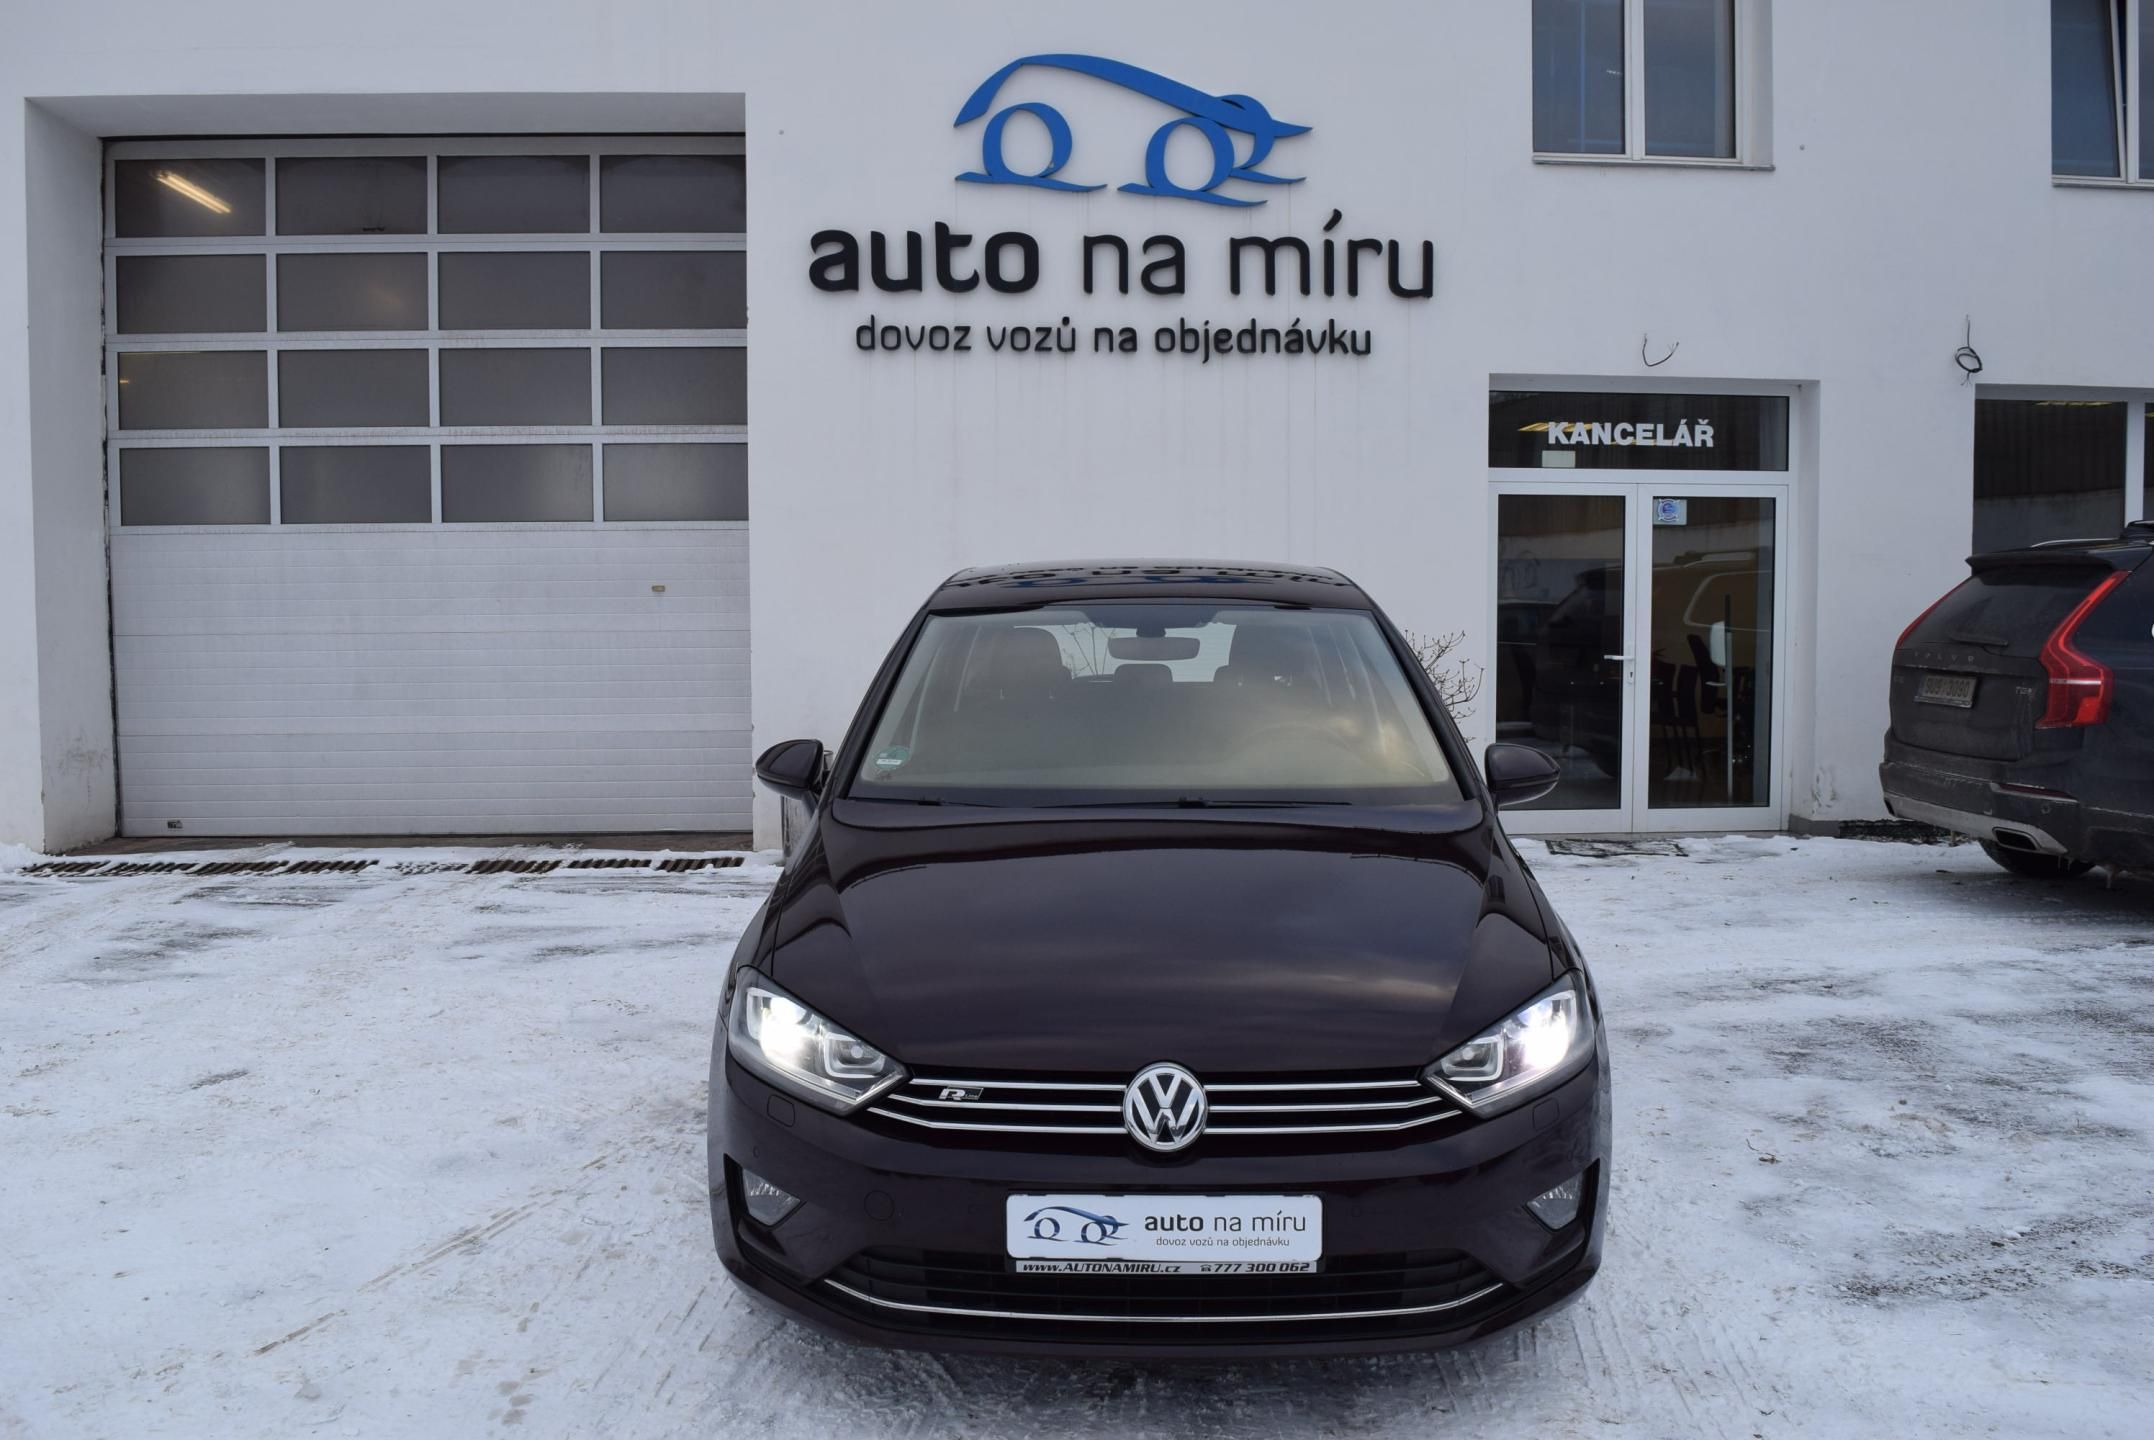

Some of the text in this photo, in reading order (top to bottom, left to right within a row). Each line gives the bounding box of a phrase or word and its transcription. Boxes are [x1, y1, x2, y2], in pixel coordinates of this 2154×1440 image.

[809, 208, 1434, 299] auto na míru
[856, 314, 1372, 364] dovoz vozů na objednávku
[1548, 418, 1715, 448] KANCELÁŘ
[1144, 1210, 1306, 1232] auto na míru
[1156, 1236, 1290, 1248] dovoz vozů na objednávku
[1023, 1263, 1310, 1273] www.AUTONAMIRU.cz 777 300 062
